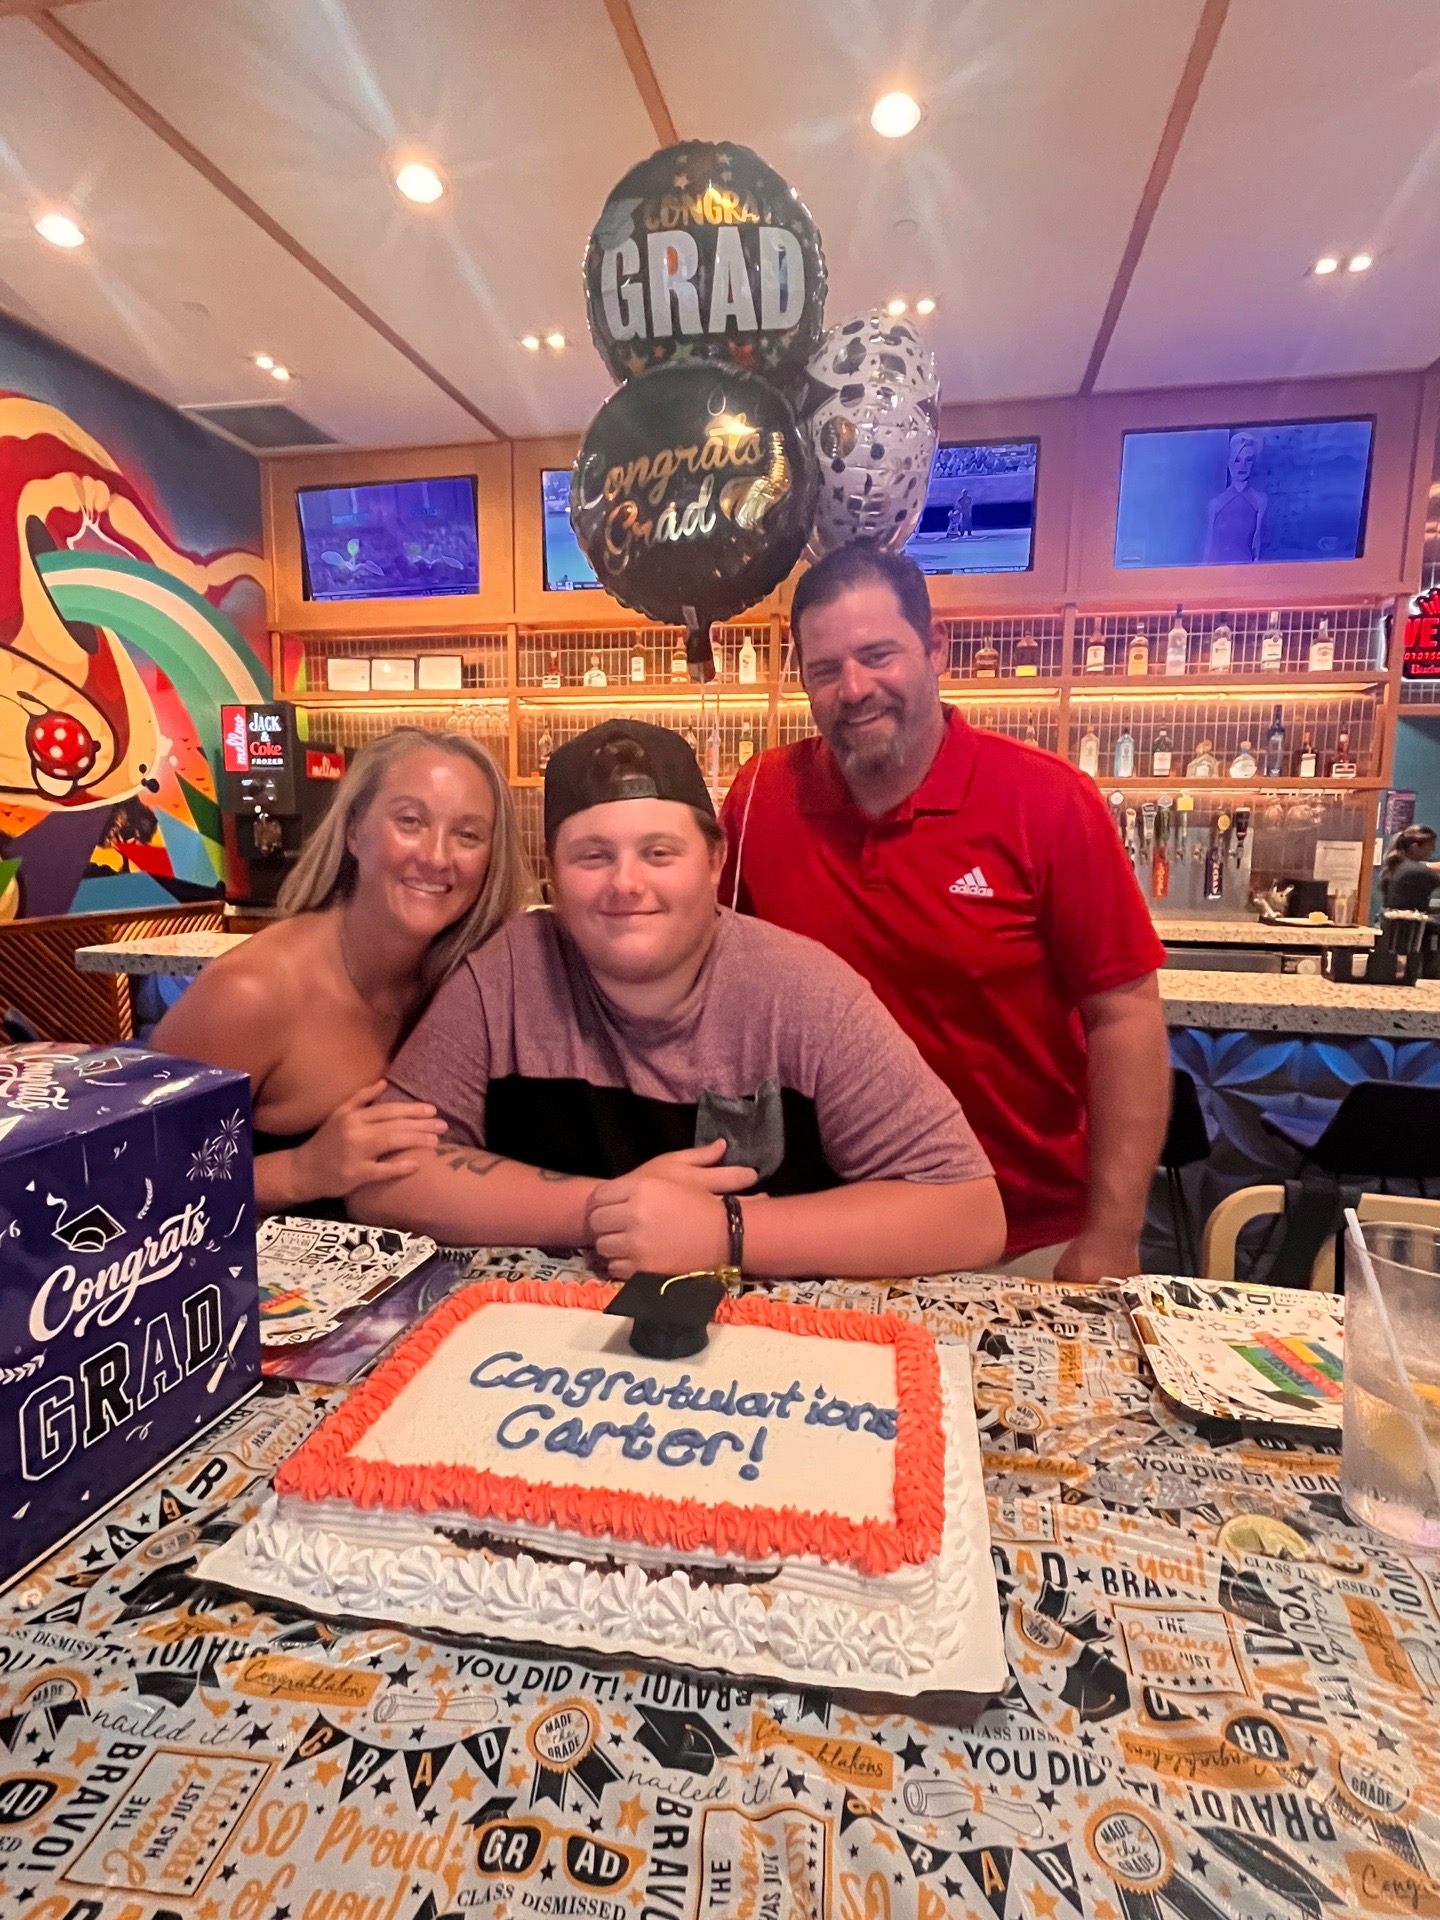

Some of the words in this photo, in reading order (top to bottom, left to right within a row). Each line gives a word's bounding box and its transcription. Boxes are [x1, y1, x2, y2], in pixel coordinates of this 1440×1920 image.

[600, 225, 806, 342] GRAD
[579, 412, 764, 510] Congrats
[603, 473, 717, 575] Grad
[226, 713, 247, 766] mellow
[249, 712, 282, 732] JACK
[260, 731, 271, 742] &
[249, 742, 282, 756] Coke
[948, 884, 994, 898] adidas
[299, 1232, 340, 1266] GRAD
[28, 1196, 208, 1342] Congrats
[18, 1283, 223, 1482] GRAD
[469, 1350, 900, 1441] Congratulations
[496, 1403, 768, 1481] Carter!
[1132, 1455, 1187, 1476] YOU
[1192, 1464, 1235, 1482] DID
[1240, 1471, 1275, 1489] IT!
[1136, 1545, 1209, 1590] you!
[1244, 1555, 1293, 1580] CLASS
[1154, 1614, 1188, 1635] THE
[455, 1654, 518, 1687] YOU
[523, 1665, 574, 1693] DID
[579, 1672, 620, 1699] IT!
[91, 1704, 196, 1742] nailed
[545, 1712, 573, 1734] MADE
[1233, 1724, 1282, 1759] GR
[547, 1738, 581, 1761] GRADE
[963, 1741, 1038, 1781] YOU
[1047, 1750, 1107, 1787] DID
[3, 1781, 50, 1817] AD
[627, 1770, 731, 1802] nailed
[742, 1765, 783, 1806] it!
[1351, 1776, 1394, 1808] GRADE
[18, 1742, 147, 1872] BRAVO!
[110, 1795, 152, 1831] THE
[143, 1826, 179, 1859] HAS
[170, 1781, 206, 1822] JUST
[1185, 1785, 1338, 1843] BRAVO!
[1100, 1819, 1133, 1845] MADE
[483, 1830, 529, 1867] GR
[575, 1842, 622, 1880] AD
[1117, 1857, 1155, 1876] GRADE
[456, 1883, 516, 1909] CLASS
[521, 1891, 628, 1920] DISMISSED
[708, 1859, 732, 1908] THE
